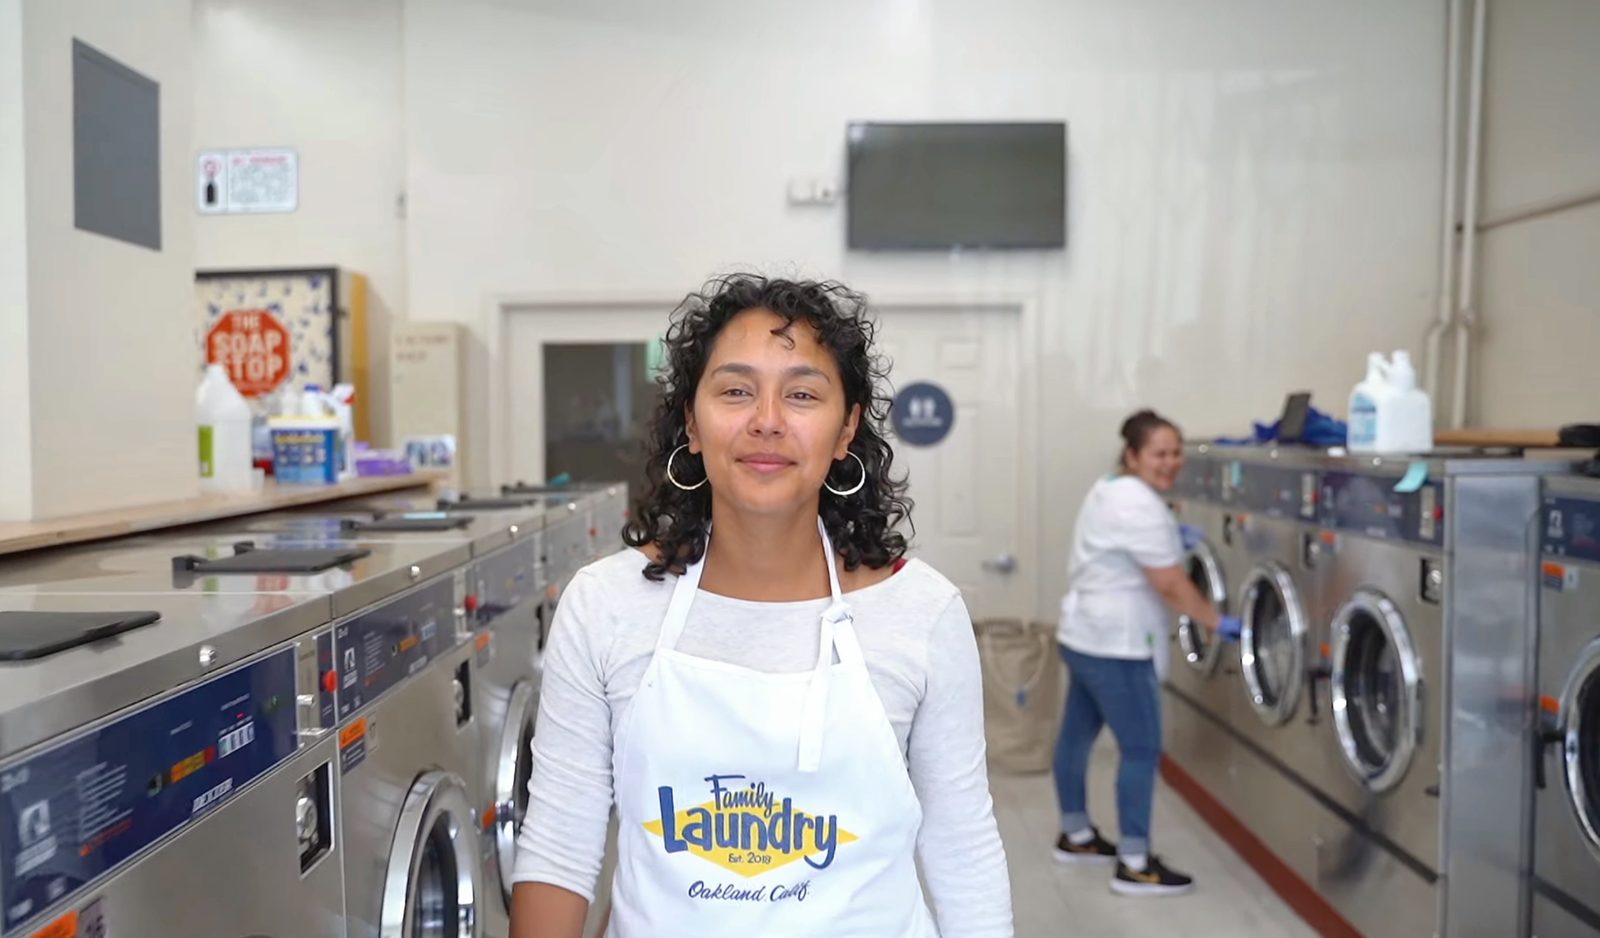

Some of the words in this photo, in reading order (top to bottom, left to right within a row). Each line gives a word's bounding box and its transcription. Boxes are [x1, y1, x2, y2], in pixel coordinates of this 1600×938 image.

[231, 313, 260, 330] THE
[213, 330, 282, 355] SOAP
[704, 774, 779, 817] Family
[658, 786, 837, 870] Laundry
